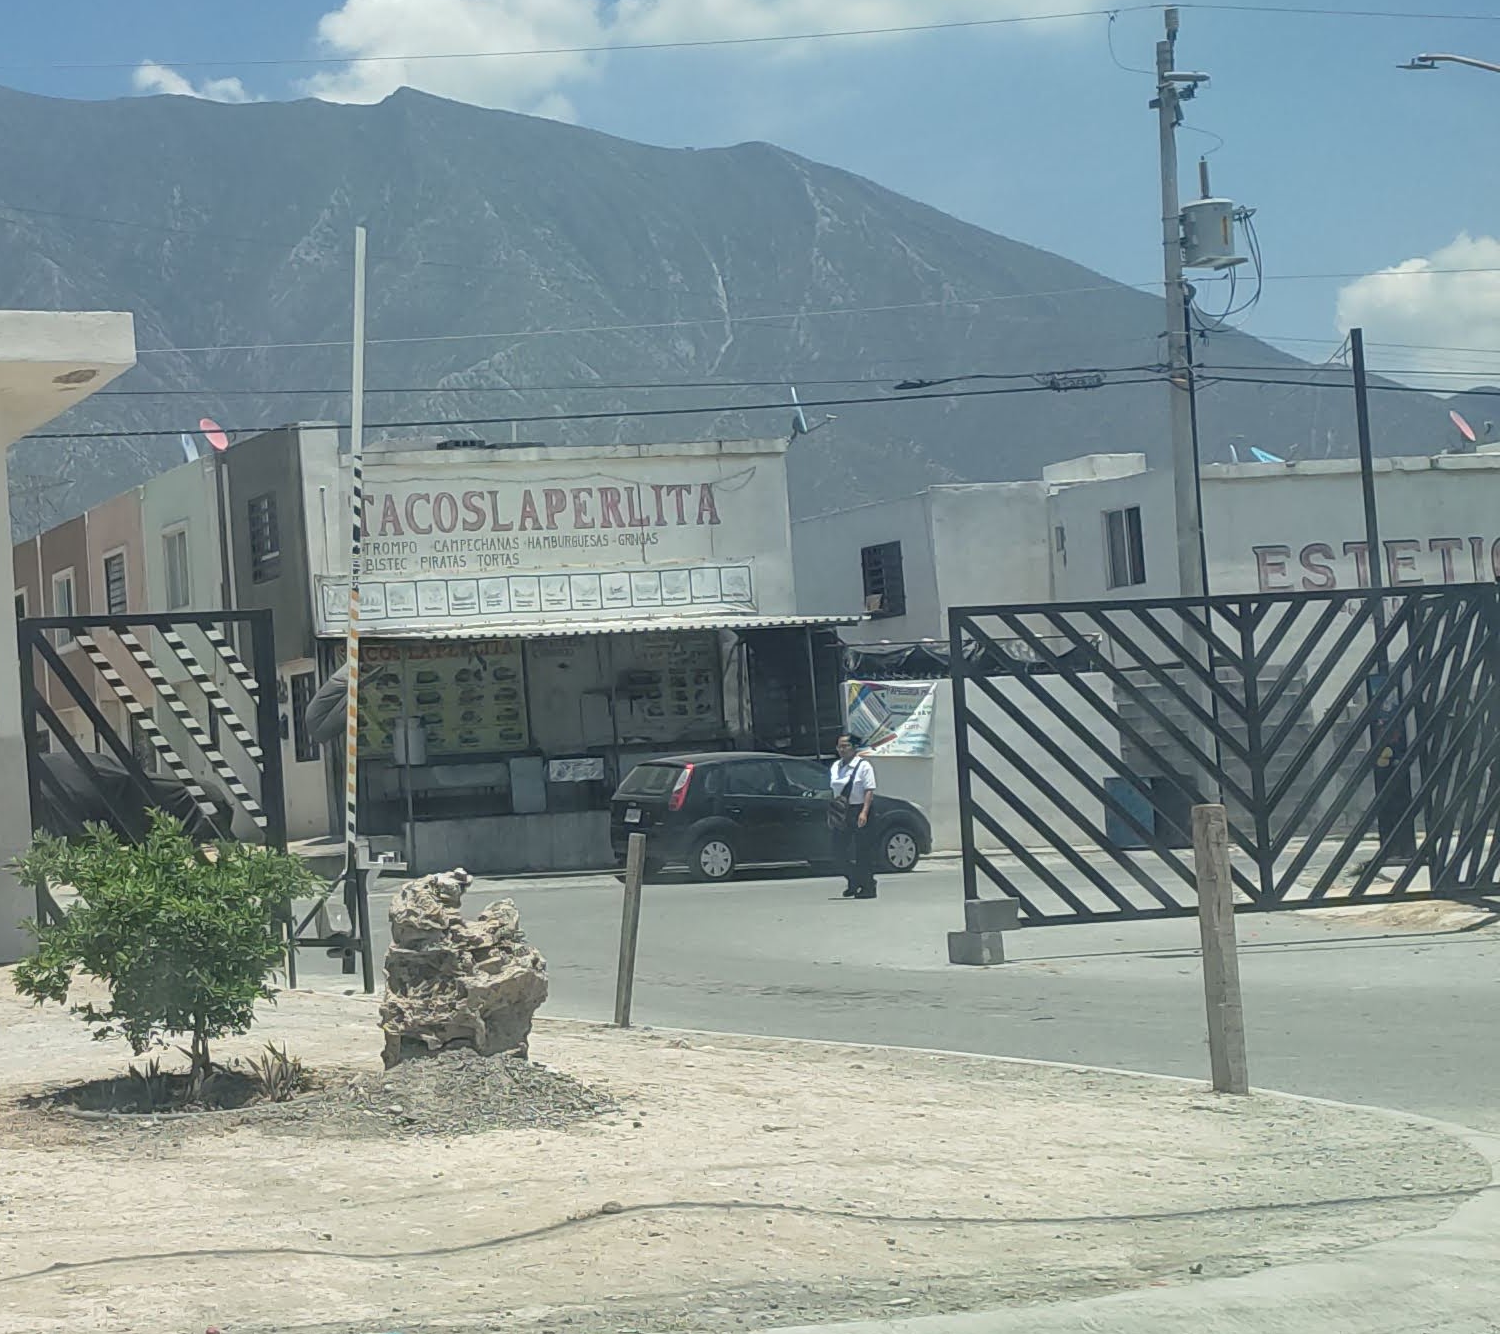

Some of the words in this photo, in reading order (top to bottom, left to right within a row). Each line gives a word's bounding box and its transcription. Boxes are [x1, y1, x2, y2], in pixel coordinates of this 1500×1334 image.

[365, 541, 417, 556] TROMPO
[434, 537, 519, 553] CAMPECHANAS
[528, 534, 609, 550] HAMBURGUESAS
[618, 532, 658, 545] GRINGAS
[366, 557, 407, 571] BISTEC
[420, 555, 467, 568] PIRATAS
[477, 553, 519, 566] TORTAS
